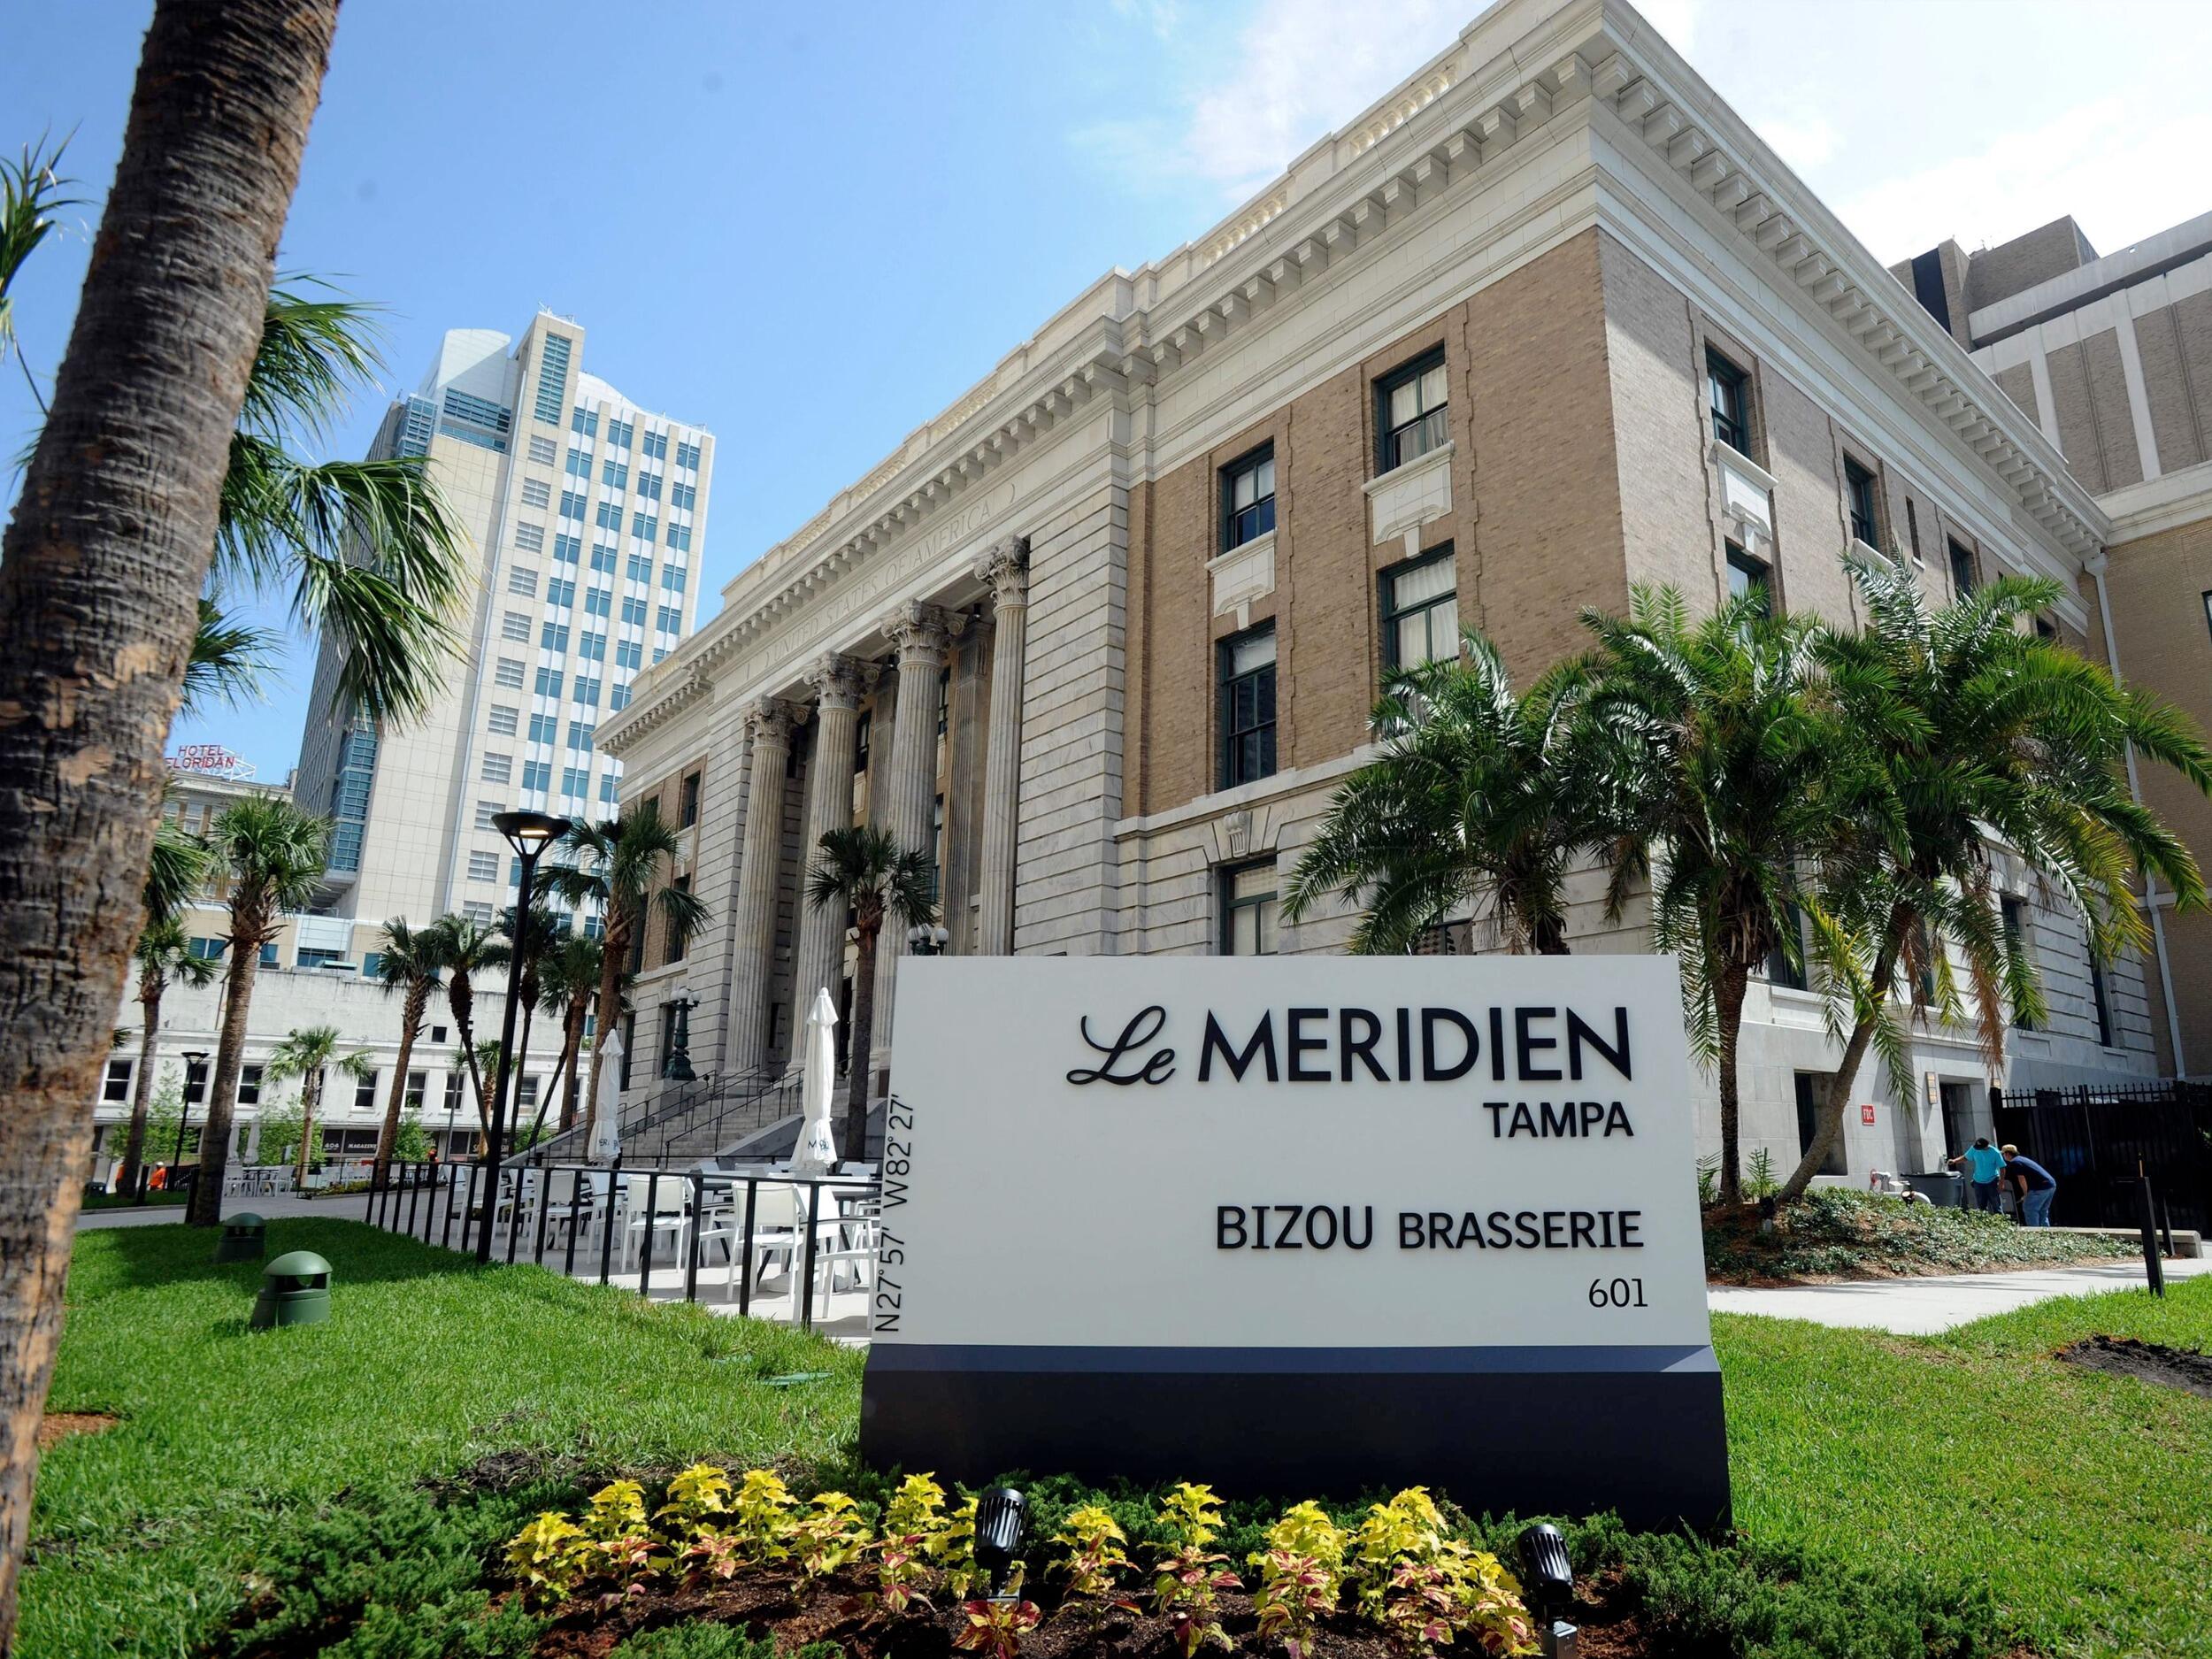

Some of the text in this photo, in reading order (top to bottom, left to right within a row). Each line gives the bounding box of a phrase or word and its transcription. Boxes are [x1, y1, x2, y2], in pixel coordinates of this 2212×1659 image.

[826, 575, 878, 624] STATES
[913, 499, 990, 568] AMERICA
[178, 745, 224, 757] HOTEL
[1066, 1005, 1632, 1086] Le MERIDIEN
[1483, 1102, 1634, 1138] TAMPA
[1217, 1205, 1645, 1250] BIZOU BRASSERIE
[1588, 1278, 1648, 1309] 601
